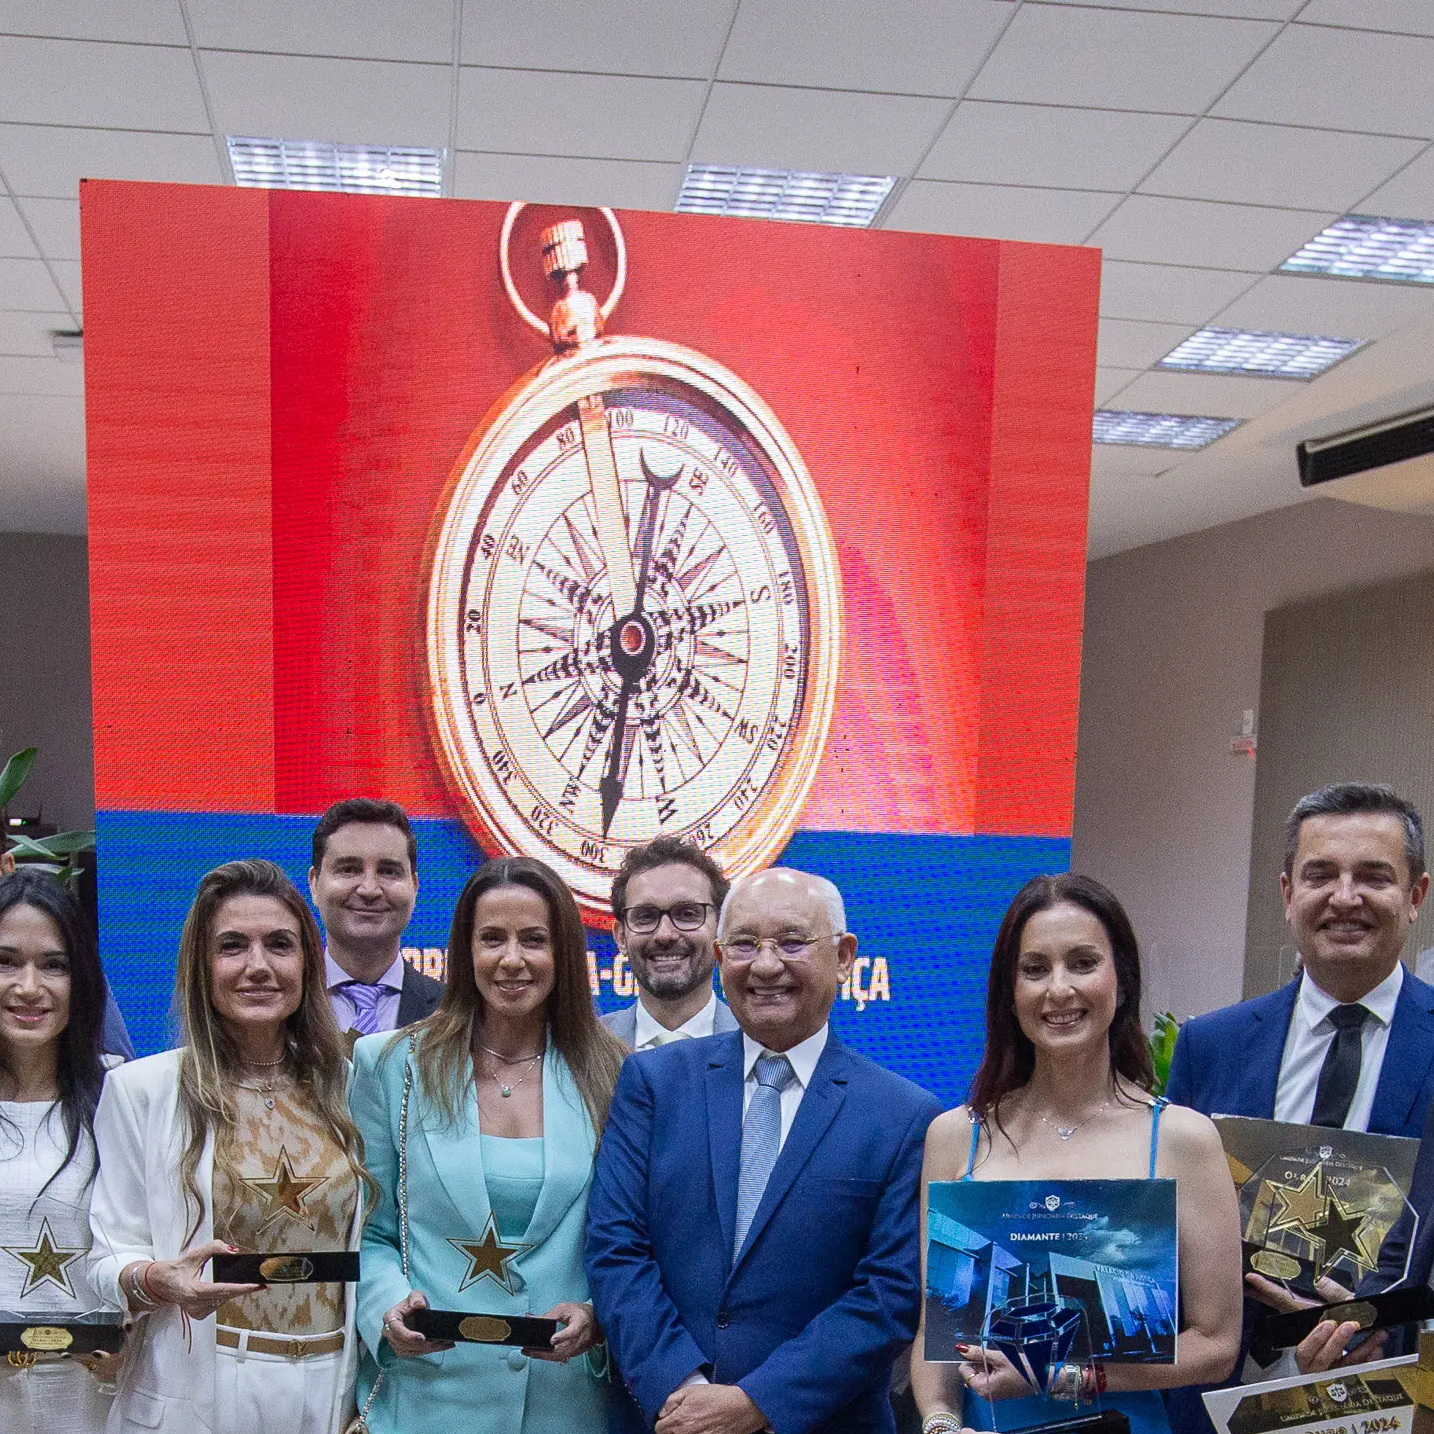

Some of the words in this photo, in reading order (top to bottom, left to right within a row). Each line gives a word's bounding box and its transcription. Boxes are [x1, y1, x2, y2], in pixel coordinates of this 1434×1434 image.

[556, 427, 575, 450] 80
[665, 414, 688, 440] 120
[511, 470, 528, 495] 60
[481, 534, 495, 560] 40
[750, 585, 770, 604] S
[466, 609, 481, 635] 20
[784, 643, 798, 679] 200
[473, 692, 486, 704] 0
[499, 682, 517, 700] N
[735, 717, 759, 744] SW
[655, 795, 678, 825] W
[580, 840, 609, 863] 300
[1010, 1233, 1060, 1241] DIAMANTE
[1360, 1415, 1401, 1434] 2024
